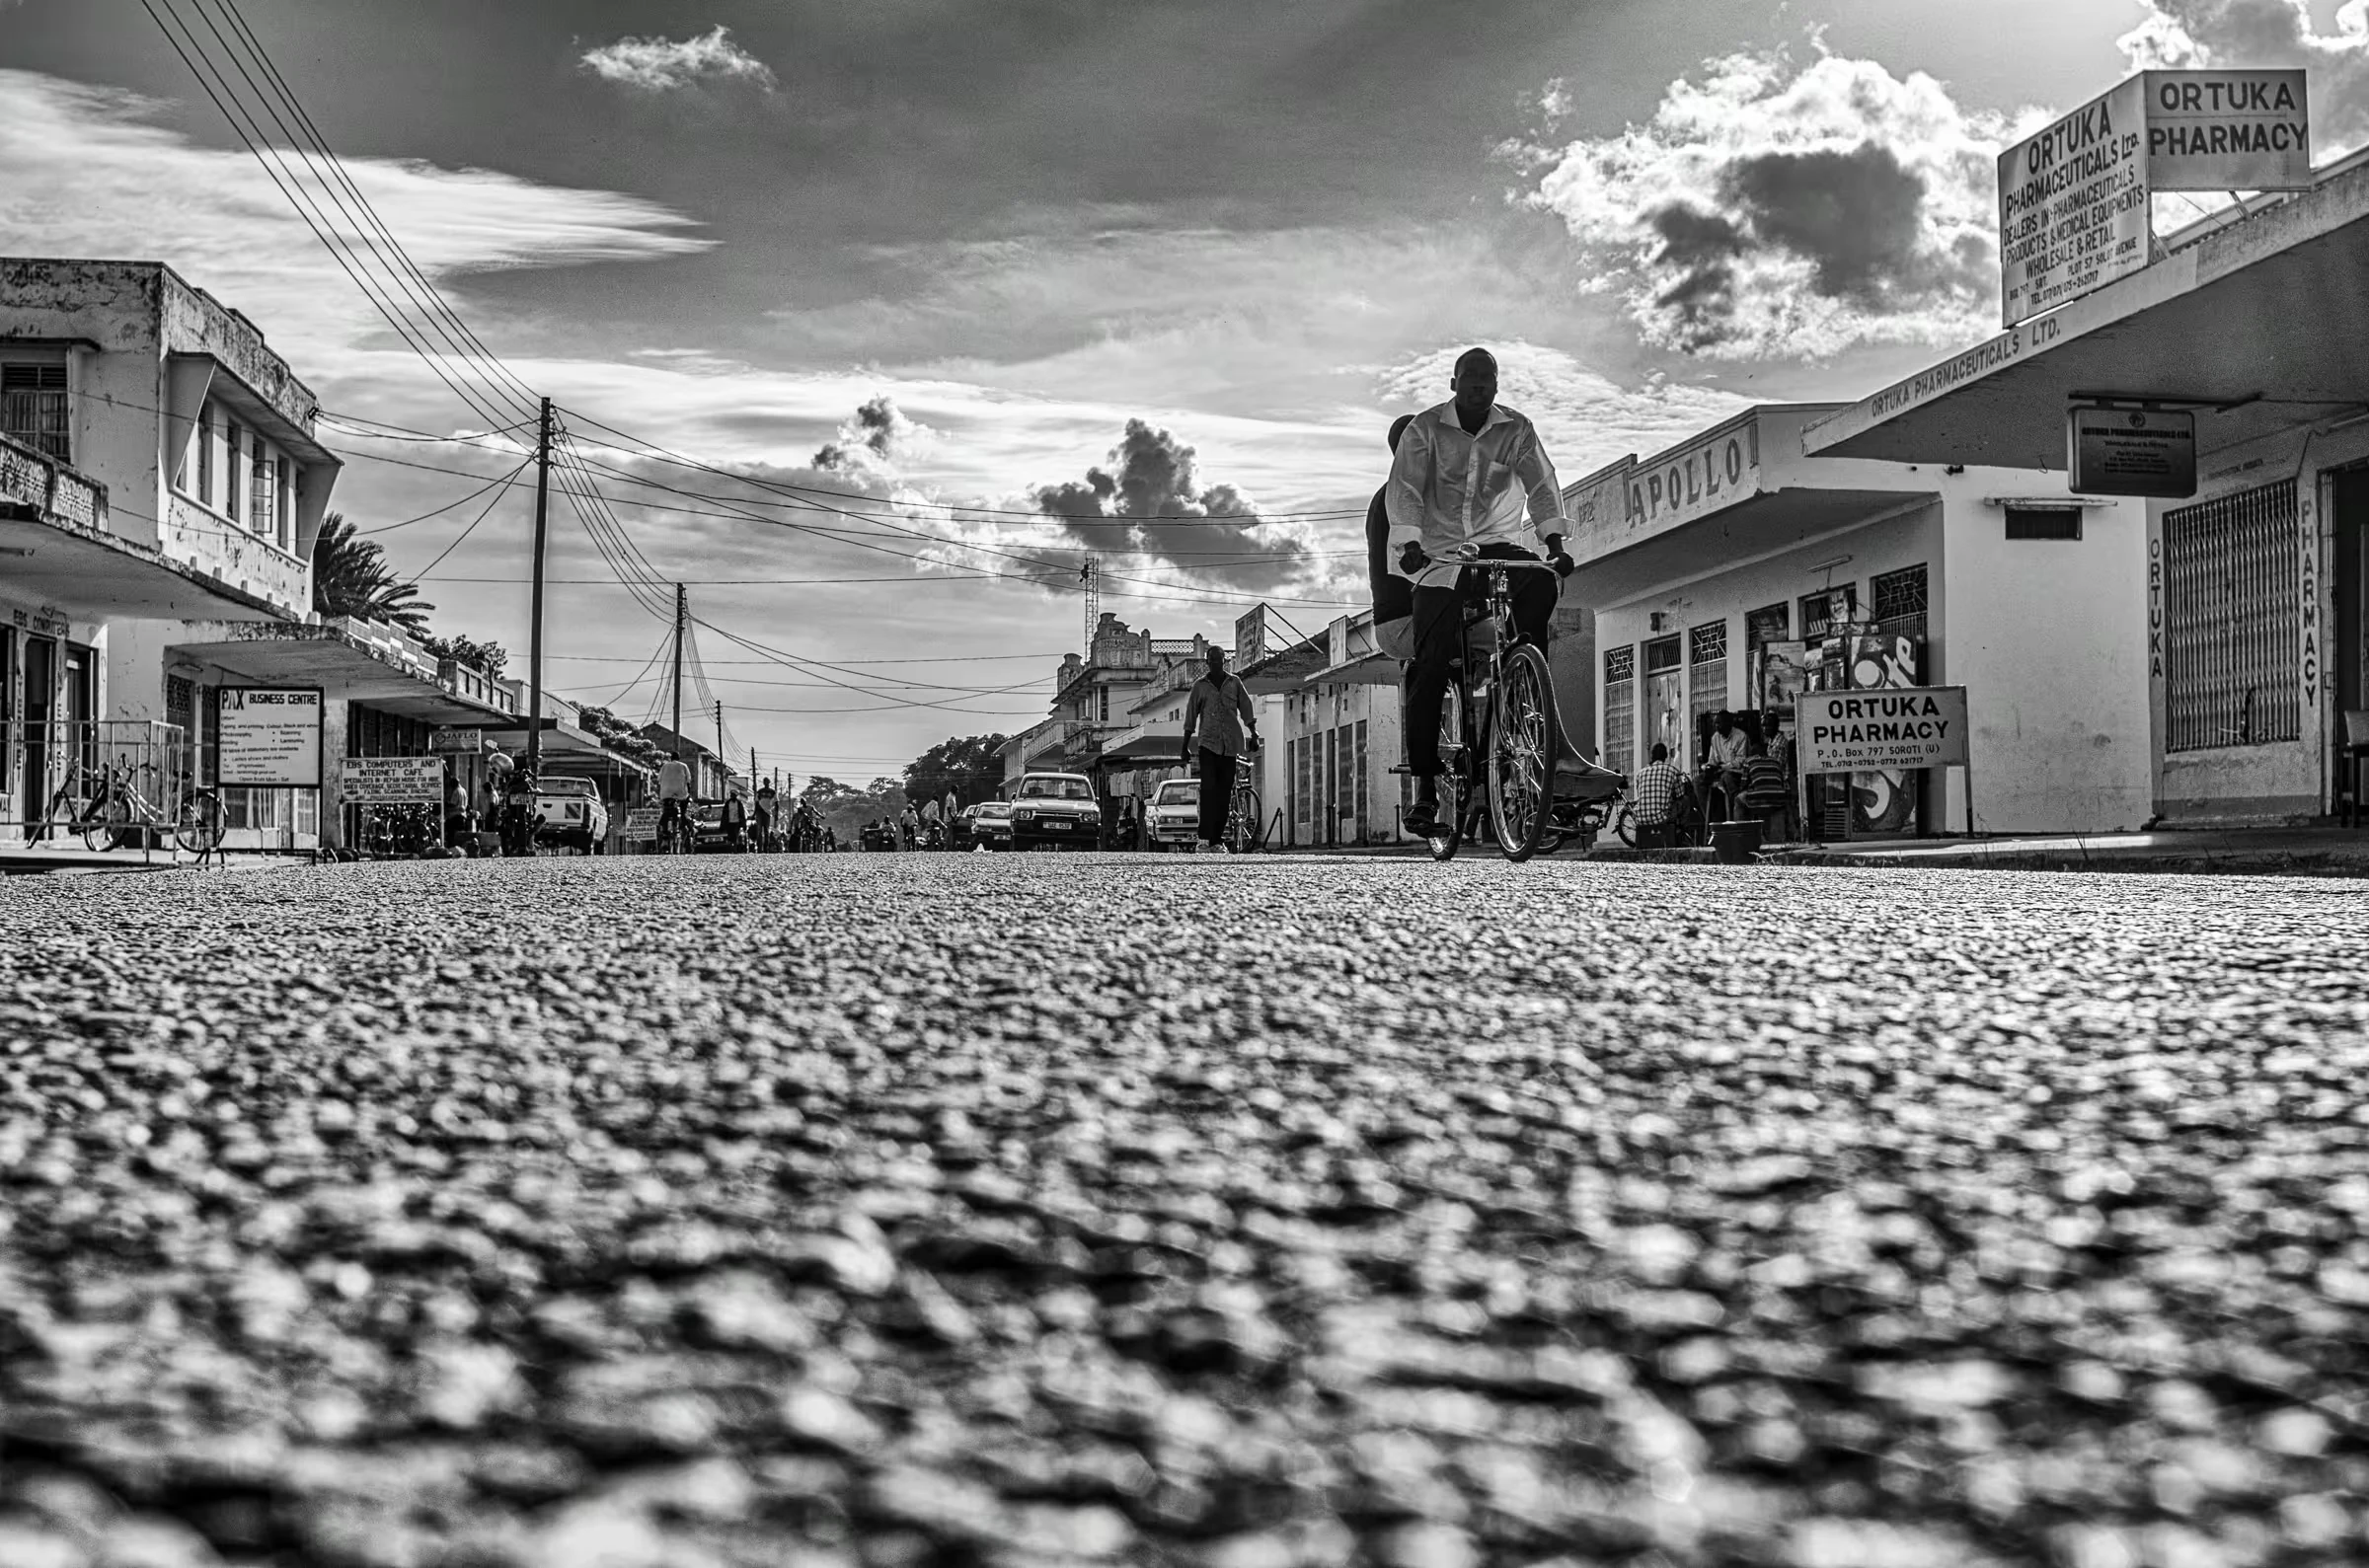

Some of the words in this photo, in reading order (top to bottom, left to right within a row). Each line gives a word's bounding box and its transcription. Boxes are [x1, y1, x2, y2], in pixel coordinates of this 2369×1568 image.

[2160, 81, 2296, 112] ORTUKA
[2027, 101, 2111, 175] ORTUKA
[2149, 121, 2309, 157] PHARMACY
[2006, 138, 2118, 219] PHARMACEUTICALS
[2004, 213, 2037, 247] DEALERS
[2054, 163, 2134, 221] PHARMACEUTICALS
[2006, 232, 2046, 268] PRODUCTS
[2050, 228, 2057, 247] &
[2056, 209, 2091, 244] MEDICAL
[2025, 240, 2074, 279] WHOLESALE
[2076, 237, 2084, 256] &
[2085, 222, 2116, 254] RETAIL
[1872, 386, 1910, 417] ORTUKA
[1914, 334, 2021, 401] PHARMACEUTICALS
[2031, 317, 2061, 346] LTD.
[1630, 437, 1741, 530] APOLLO
[13, 608, 28, 629] EBS
[2150, 538, 2163, 678] ORTUKA
[2301, 498, 2317, 708] PHARMACY
[220, 690, 245, 710] PAX
[249, 693, 284, 705] BUSINESS
[287, 694, 317, 705] CENTRE
[1828, 696, 1941, 720] ORTUKA
[1813, 720, 1949, 744] PHARMACY
[1845, 748, 1864, 758] Box
[1868, 746, 1884, 756] 797
[1889, 744, 1921, 755] SOROTI
[1925, 743, 1940, 755] (U)
[366, 760, 413, 769] COMPUTERS
[1899, 756, 1924, 765] 621717
